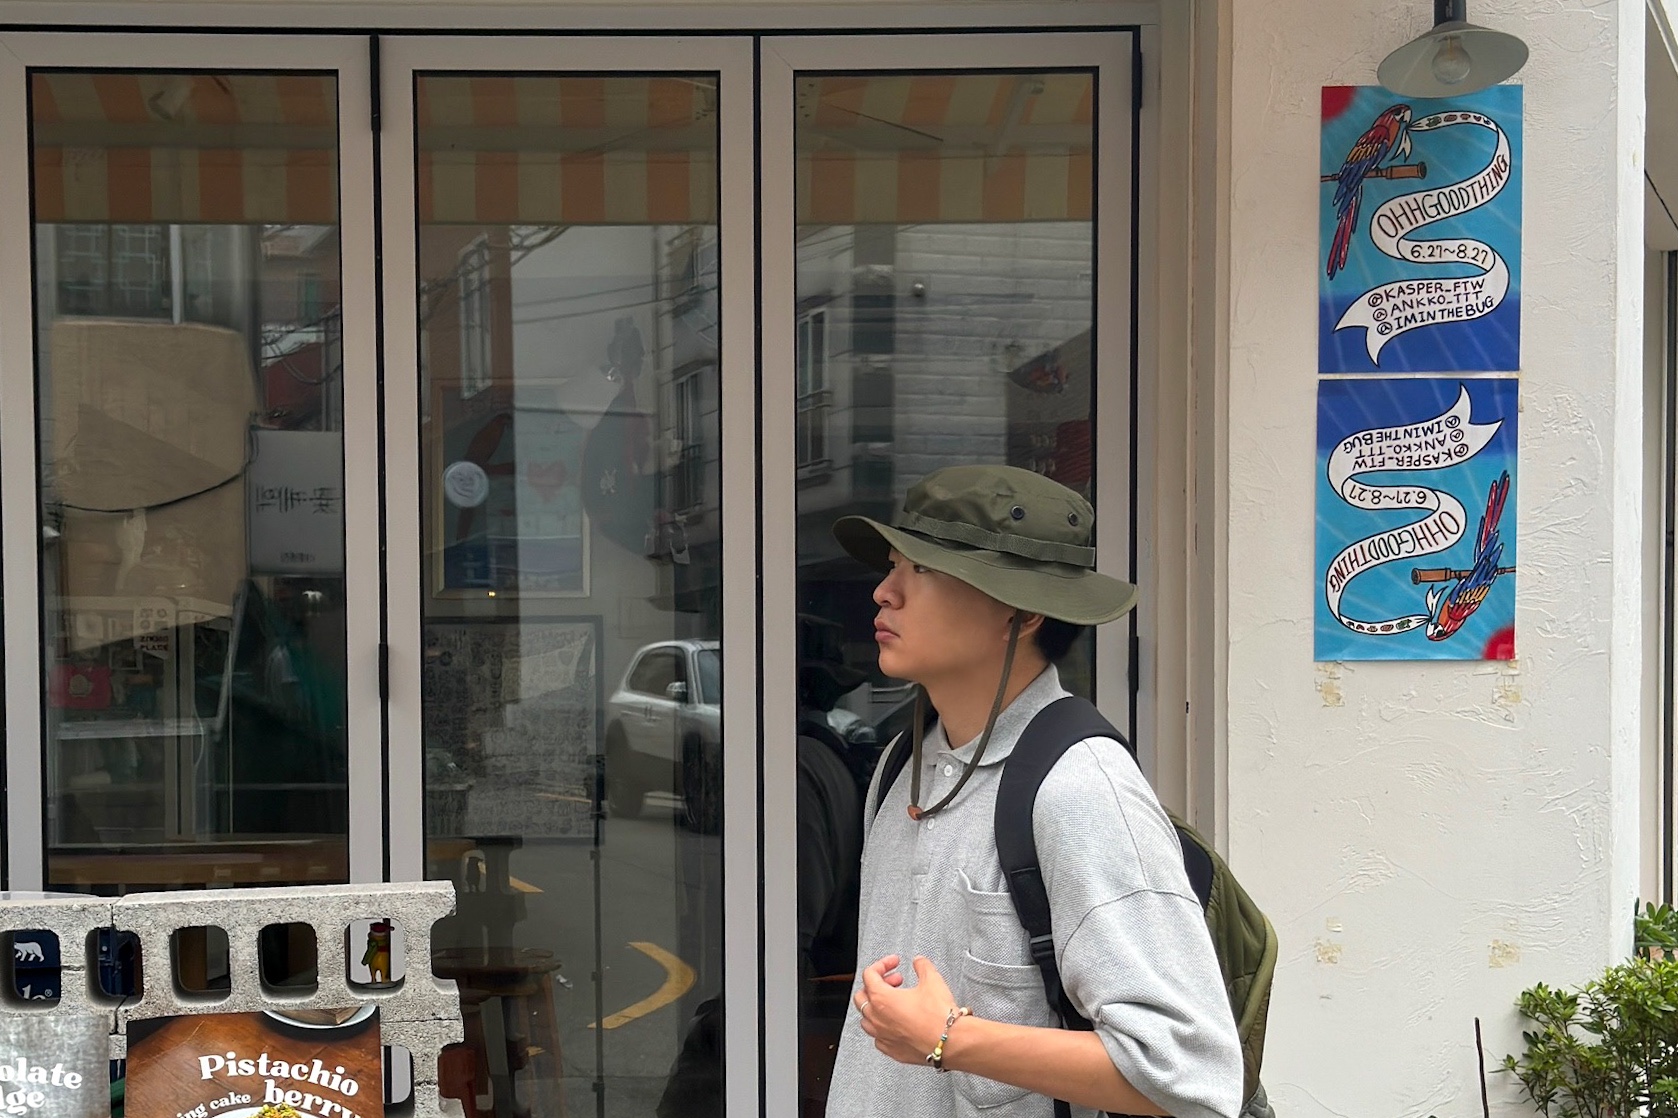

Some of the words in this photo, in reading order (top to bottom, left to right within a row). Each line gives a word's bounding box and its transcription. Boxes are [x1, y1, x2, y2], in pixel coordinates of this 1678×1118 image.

[1377, 154, 1508, 238] OHHGOODTHING
[1410, 244, 1488, 265] 6.27~8.27
[1367, 278, 1486, 307] @KASPER_FTW
[1376, 295, 1494, 335] @IMINTHEBUG
[1343, 415, 1460, 454] @IMINTHEBUG
[1352, 443, 1469, 471] @KASPER_FTW
[1348, 484, 1427, 504] 6.27~8.27
[1329, 511, 1460, 593] OHHGOODTHING
[0, 1057, 83, 1090] olate
[198, 1051, 359, 1097] Pistachio
[209, 1091, 251, 1110] cake
